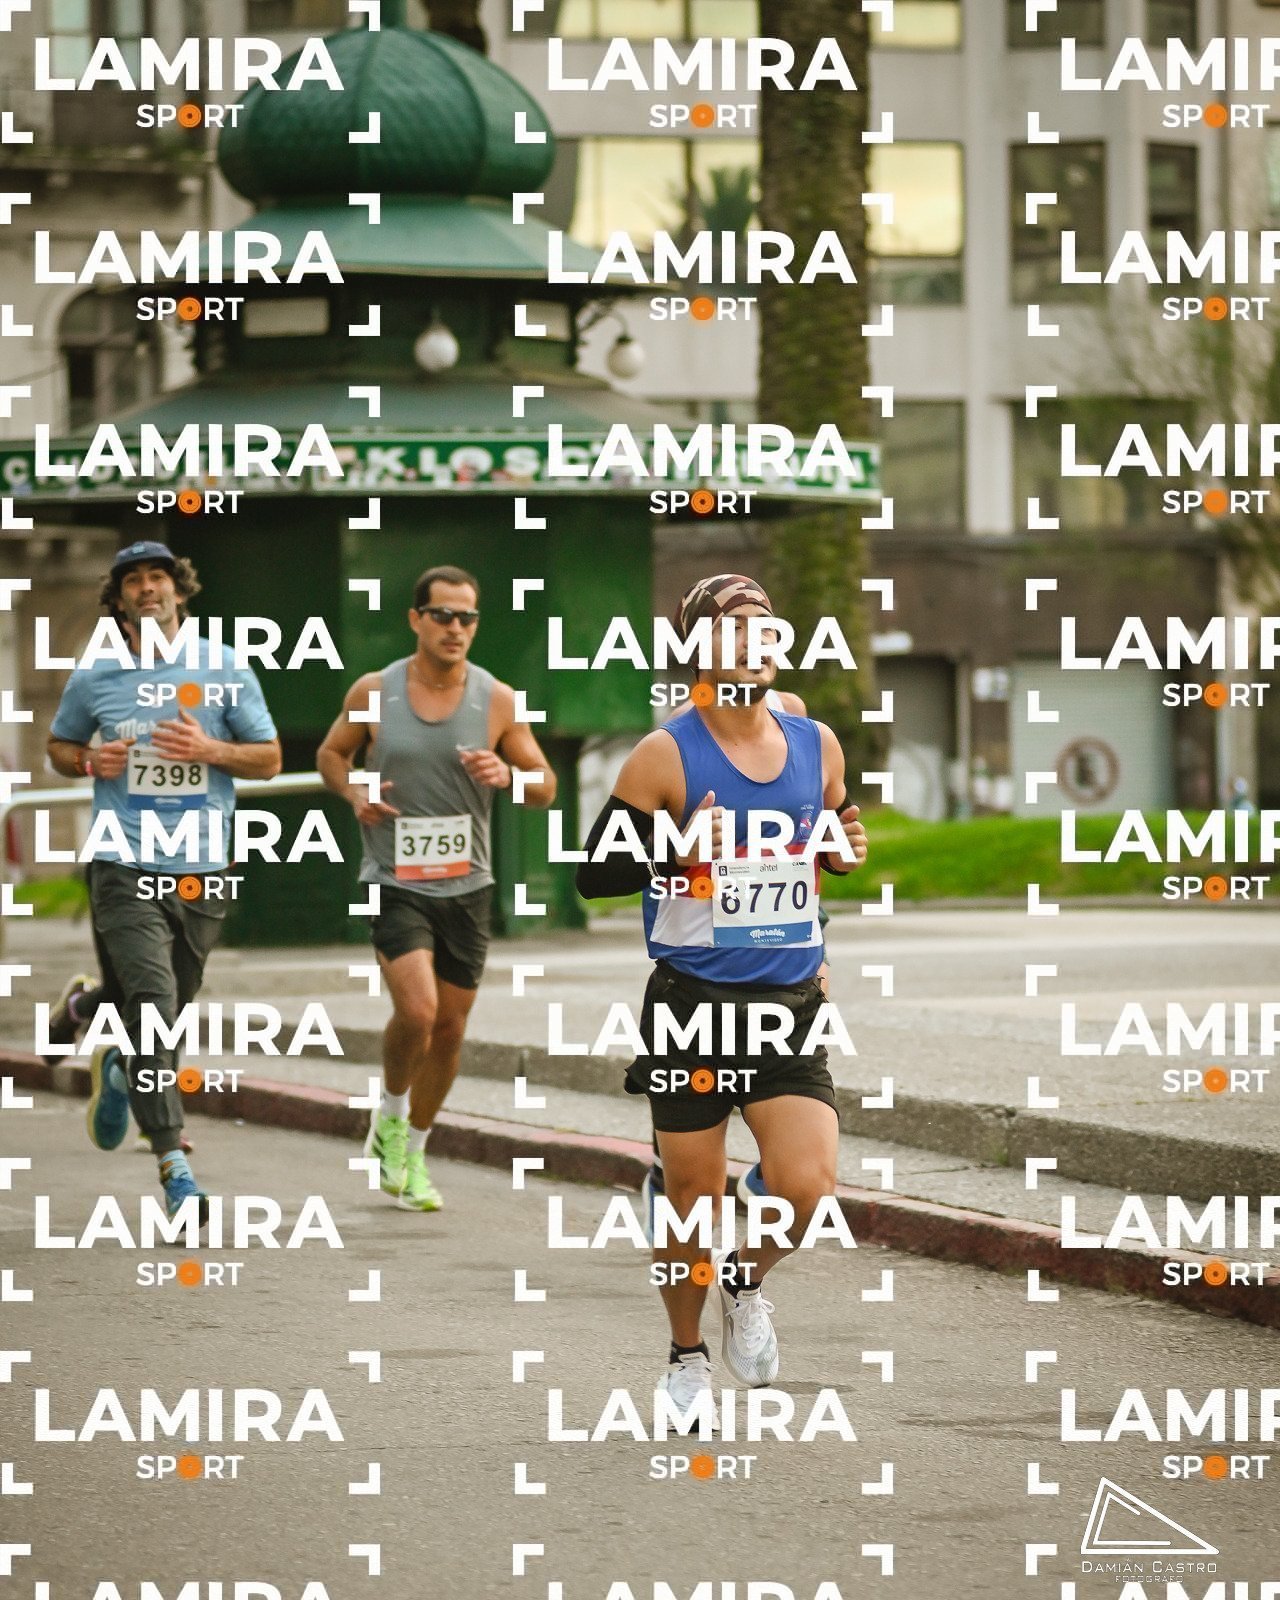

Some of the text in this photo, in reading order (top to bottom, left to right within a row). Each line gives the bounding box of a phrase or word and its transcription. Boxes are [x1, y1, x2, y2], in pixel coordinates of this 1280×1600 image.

[133, 763, 202, 787] 7398
[402, 832, 467, 857] 3759
[720, 880, 808, 915] 6770
